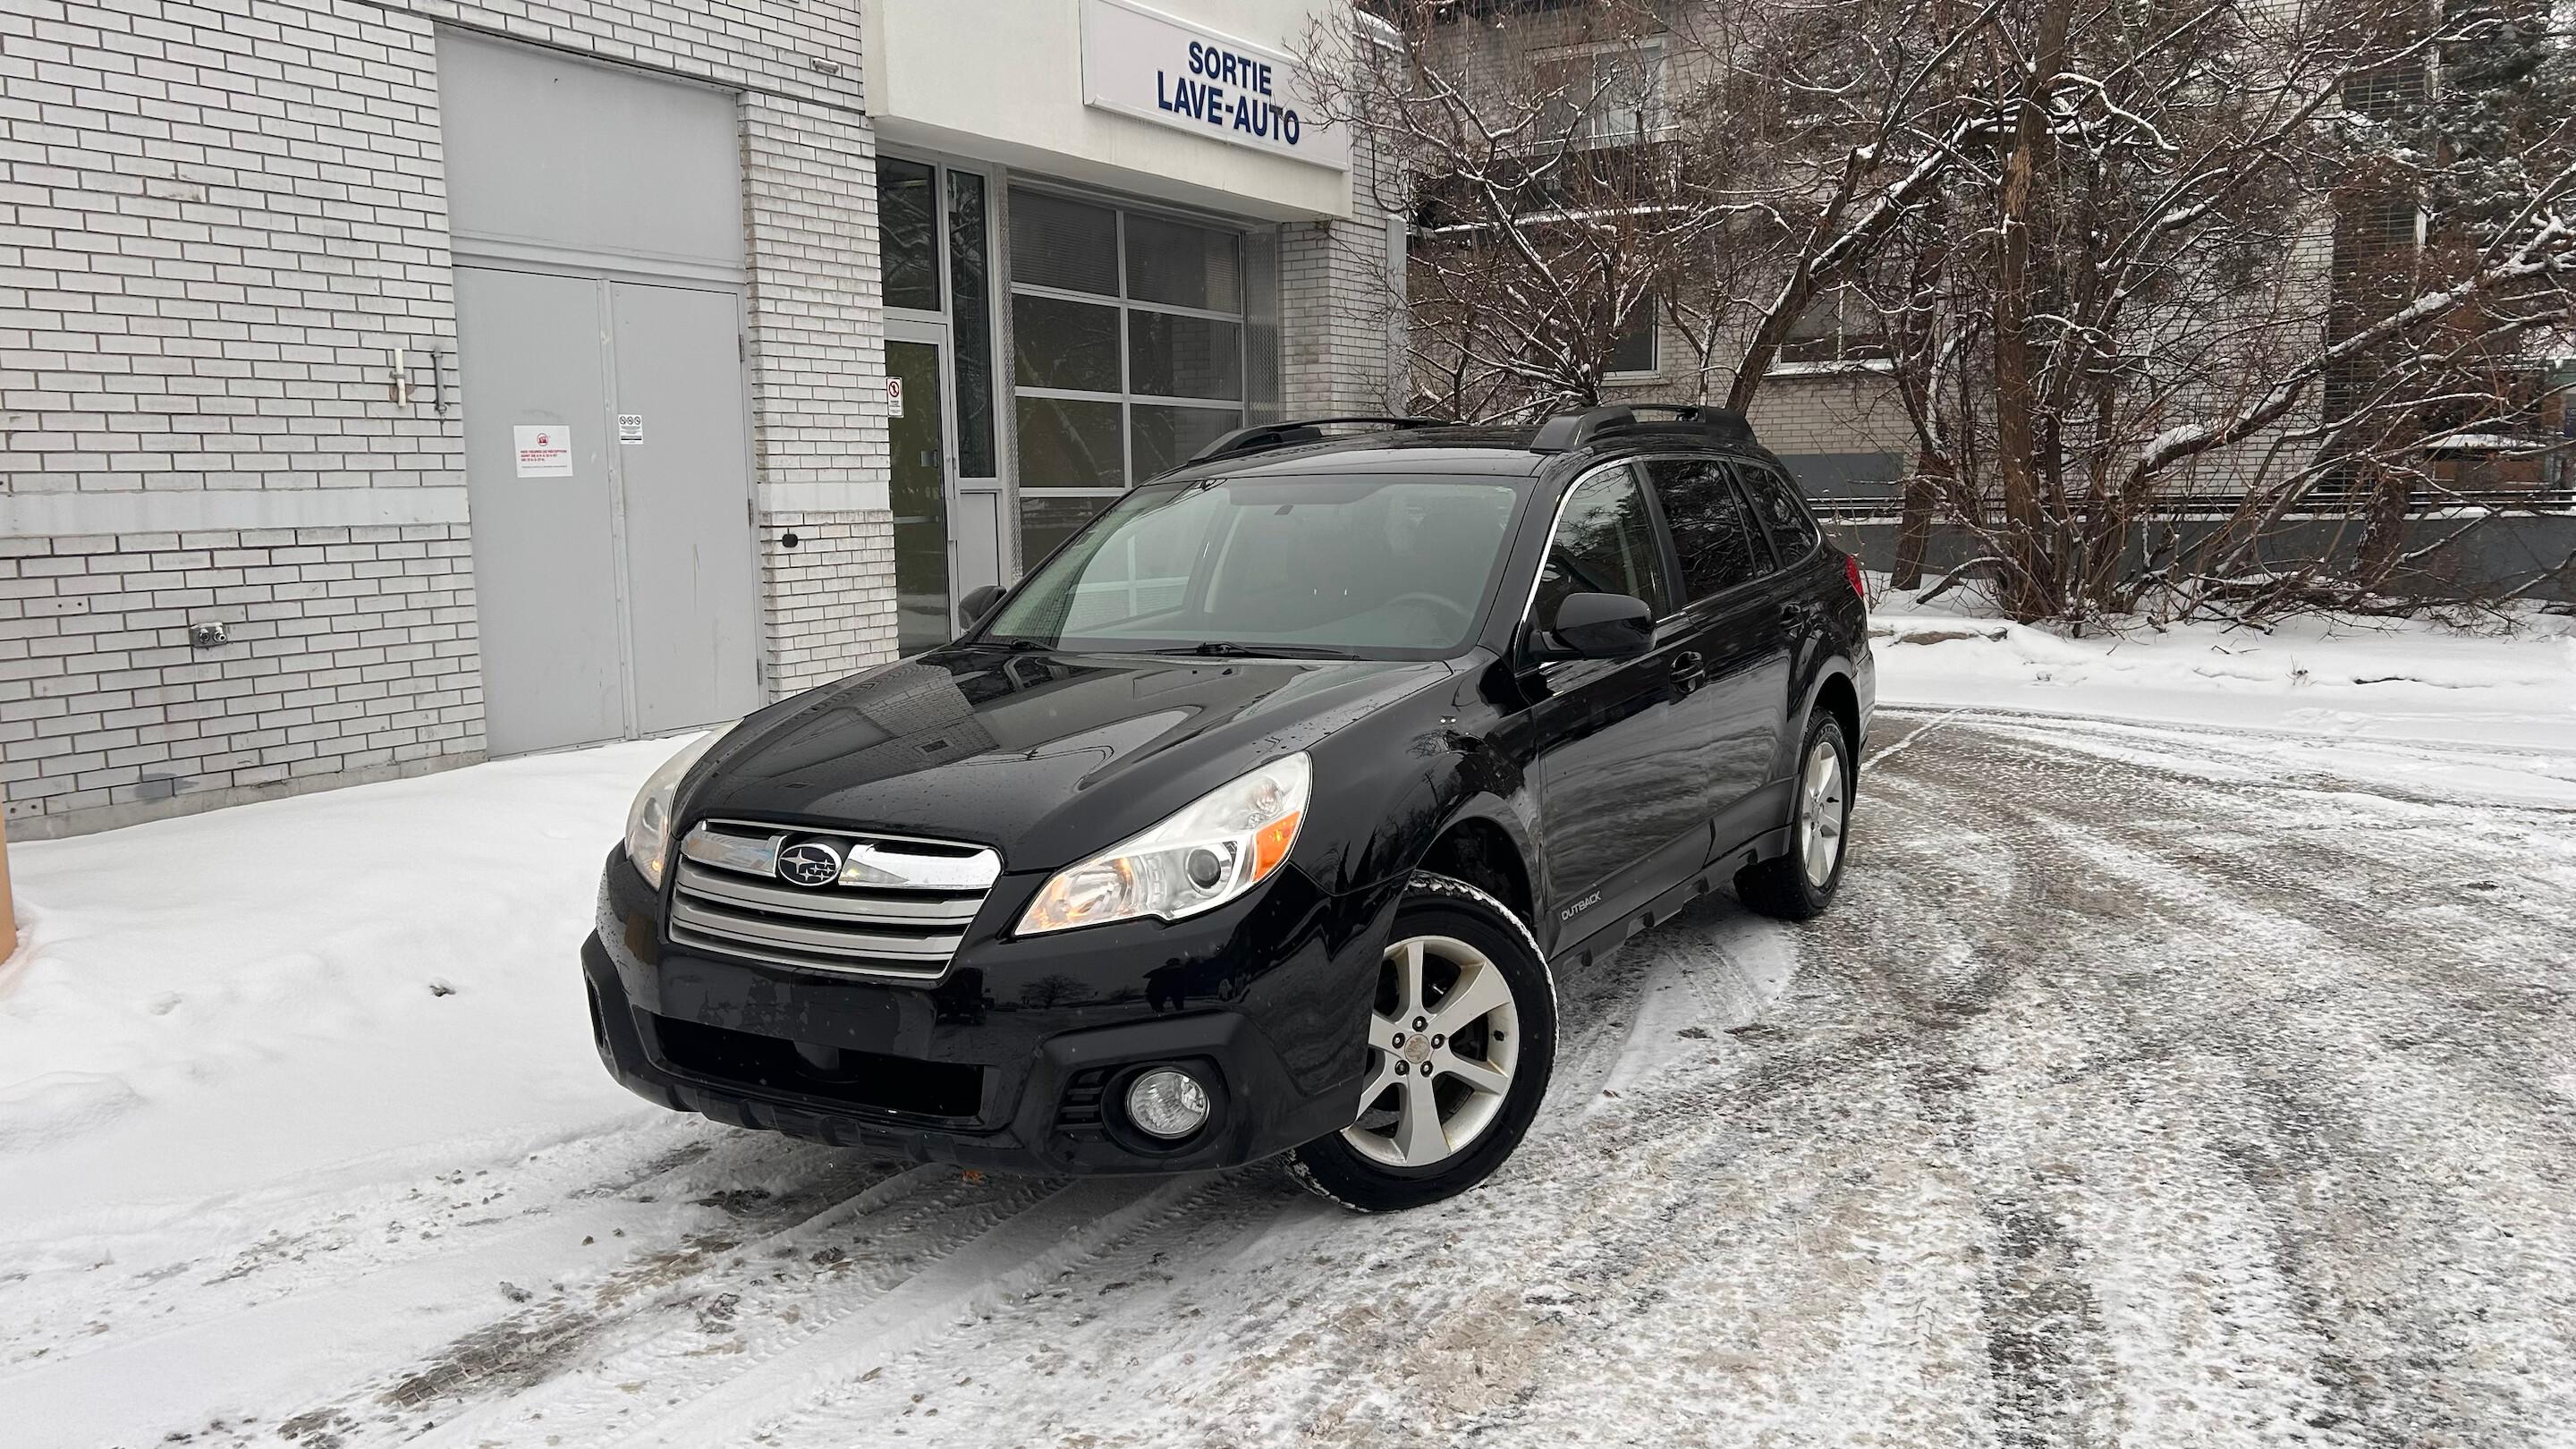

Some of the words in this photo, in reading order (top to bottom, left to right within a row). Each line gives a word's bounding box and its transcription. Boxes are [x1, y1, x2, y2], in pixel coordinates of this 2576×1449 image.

[1189, 41, 1272, 96] SORTIE
[1157, 71, 1300, 145] LAVE-AUTO
[1561, 890, 1602, 921] OUTBACK
